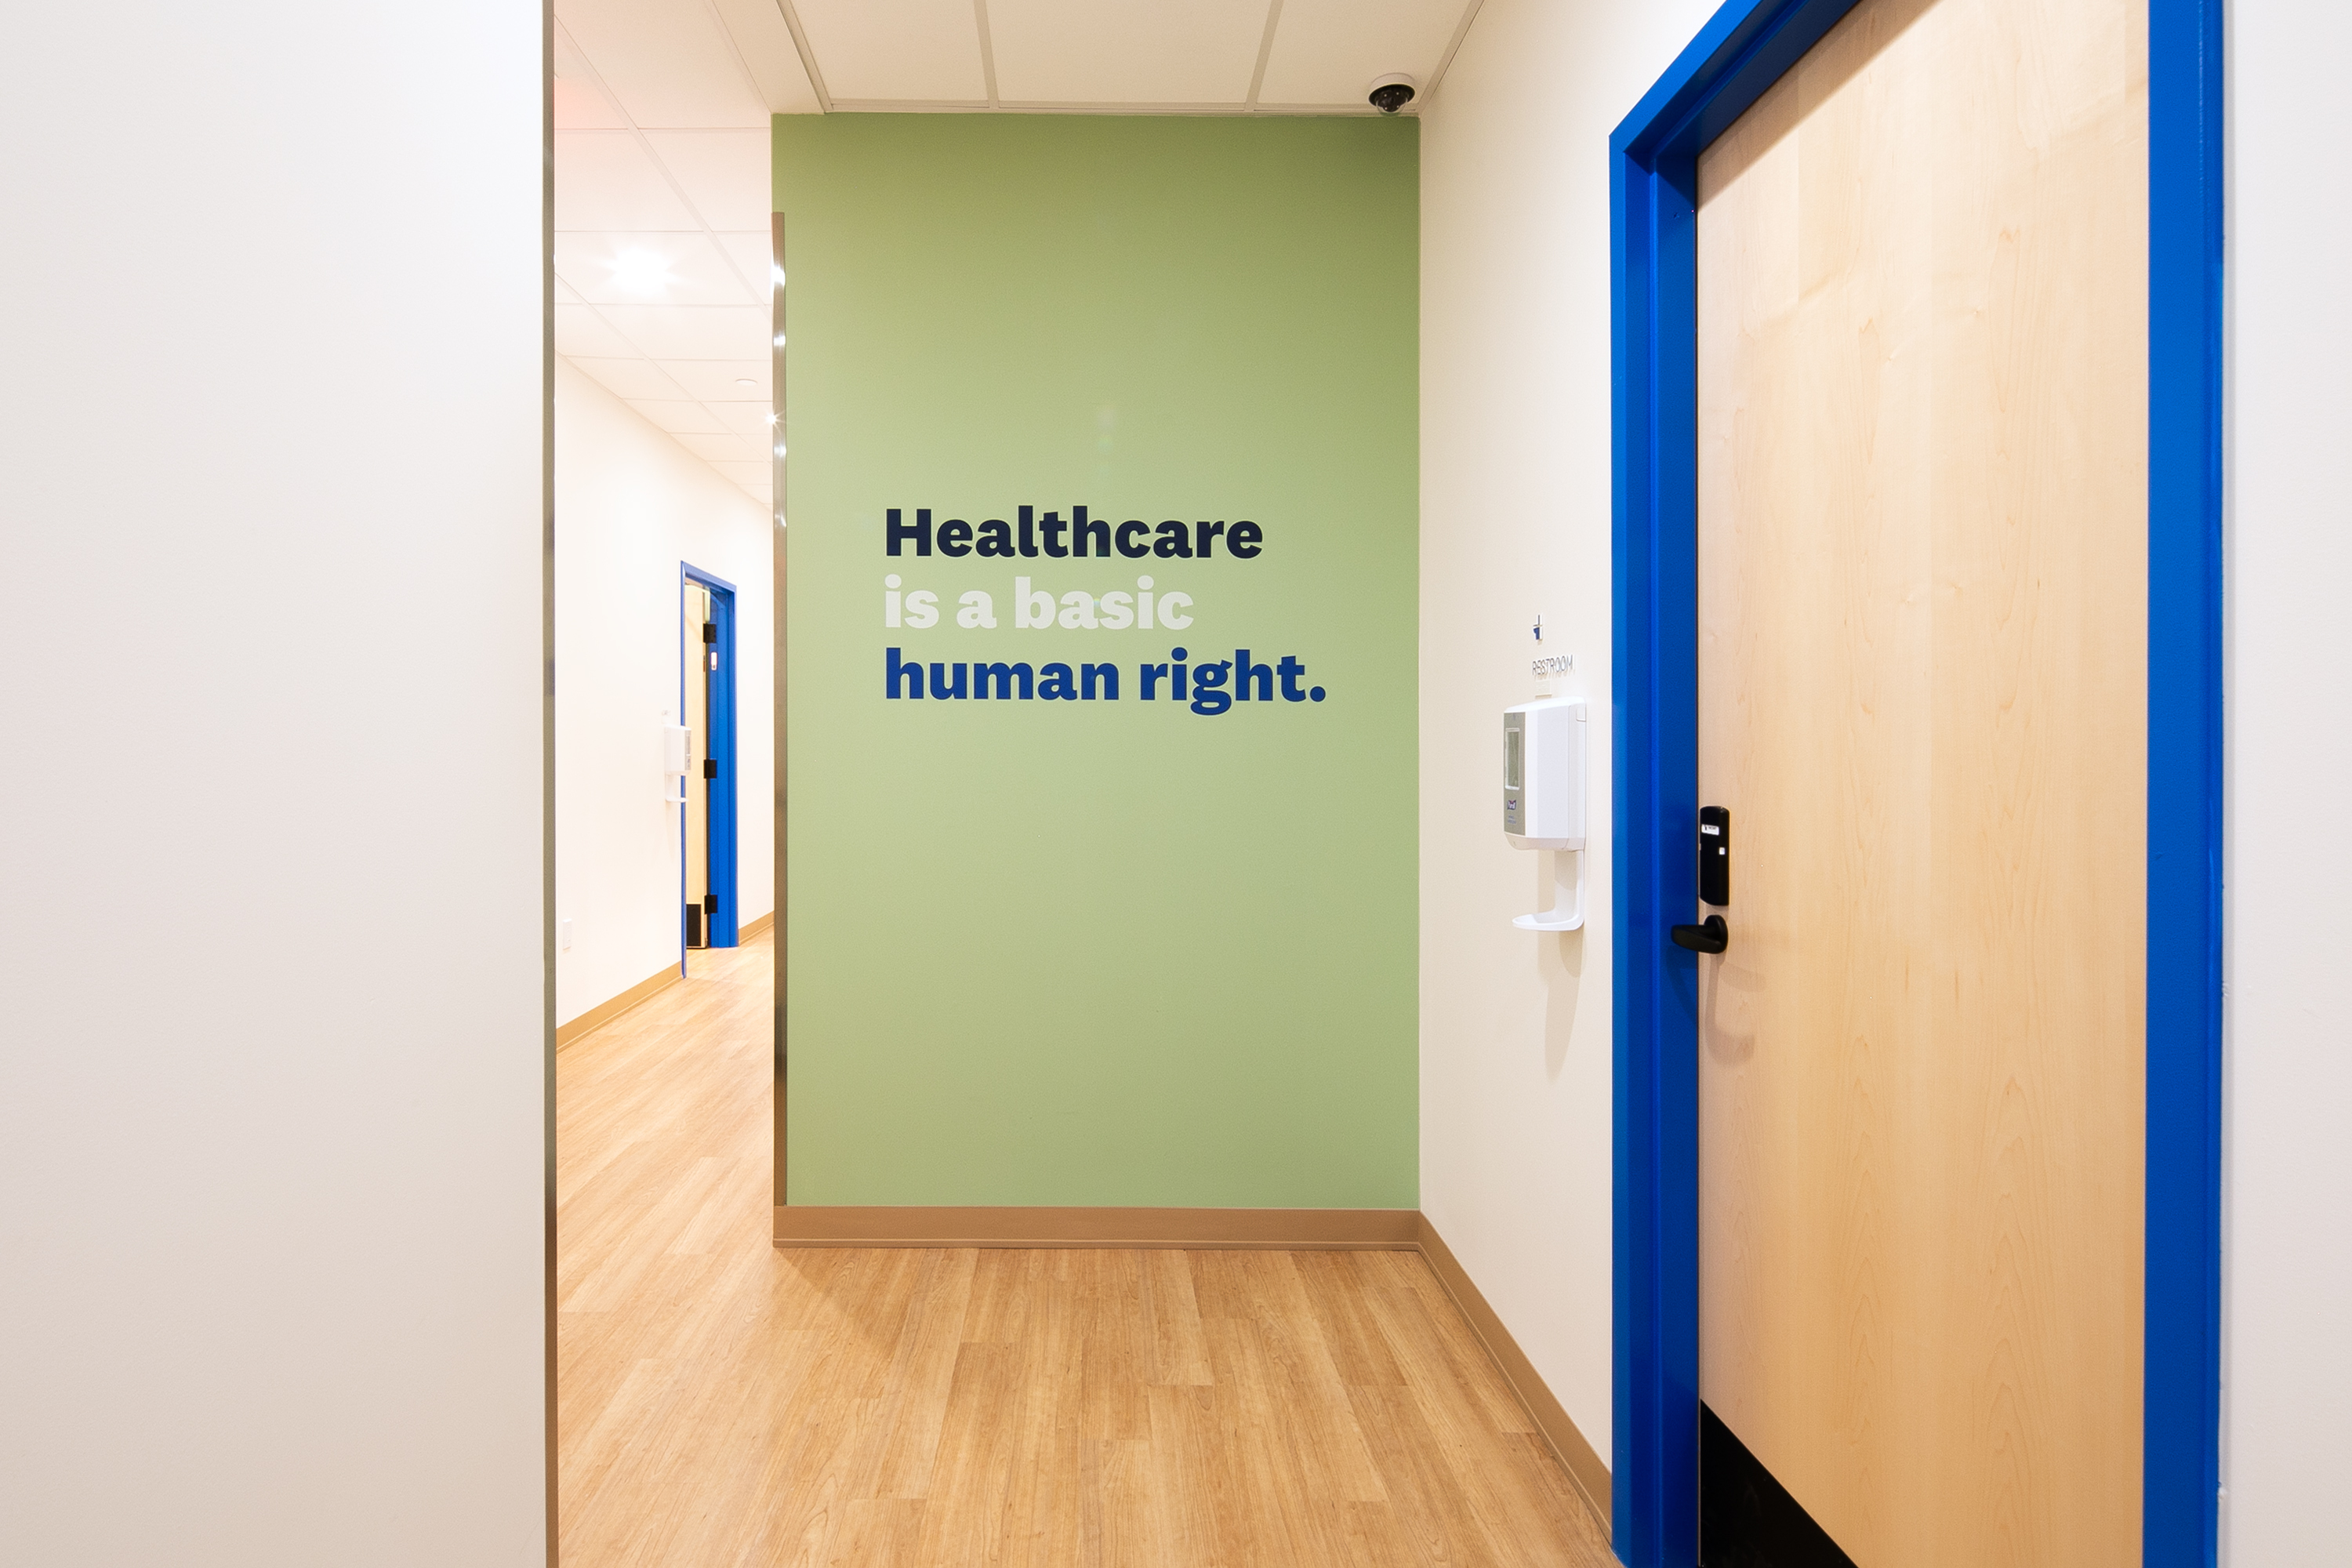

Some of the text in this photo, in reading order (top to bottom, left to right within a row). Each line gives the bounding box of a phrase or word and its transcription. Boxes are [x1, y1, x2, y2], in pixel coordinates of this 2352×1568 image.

[886, 505, 1263, 559] Healthcare
[884, 574, 1194, 630] is a basic
[886, 647, 1326, 715] human right.
[1532, 654, 1573, 676] RESTROOM
